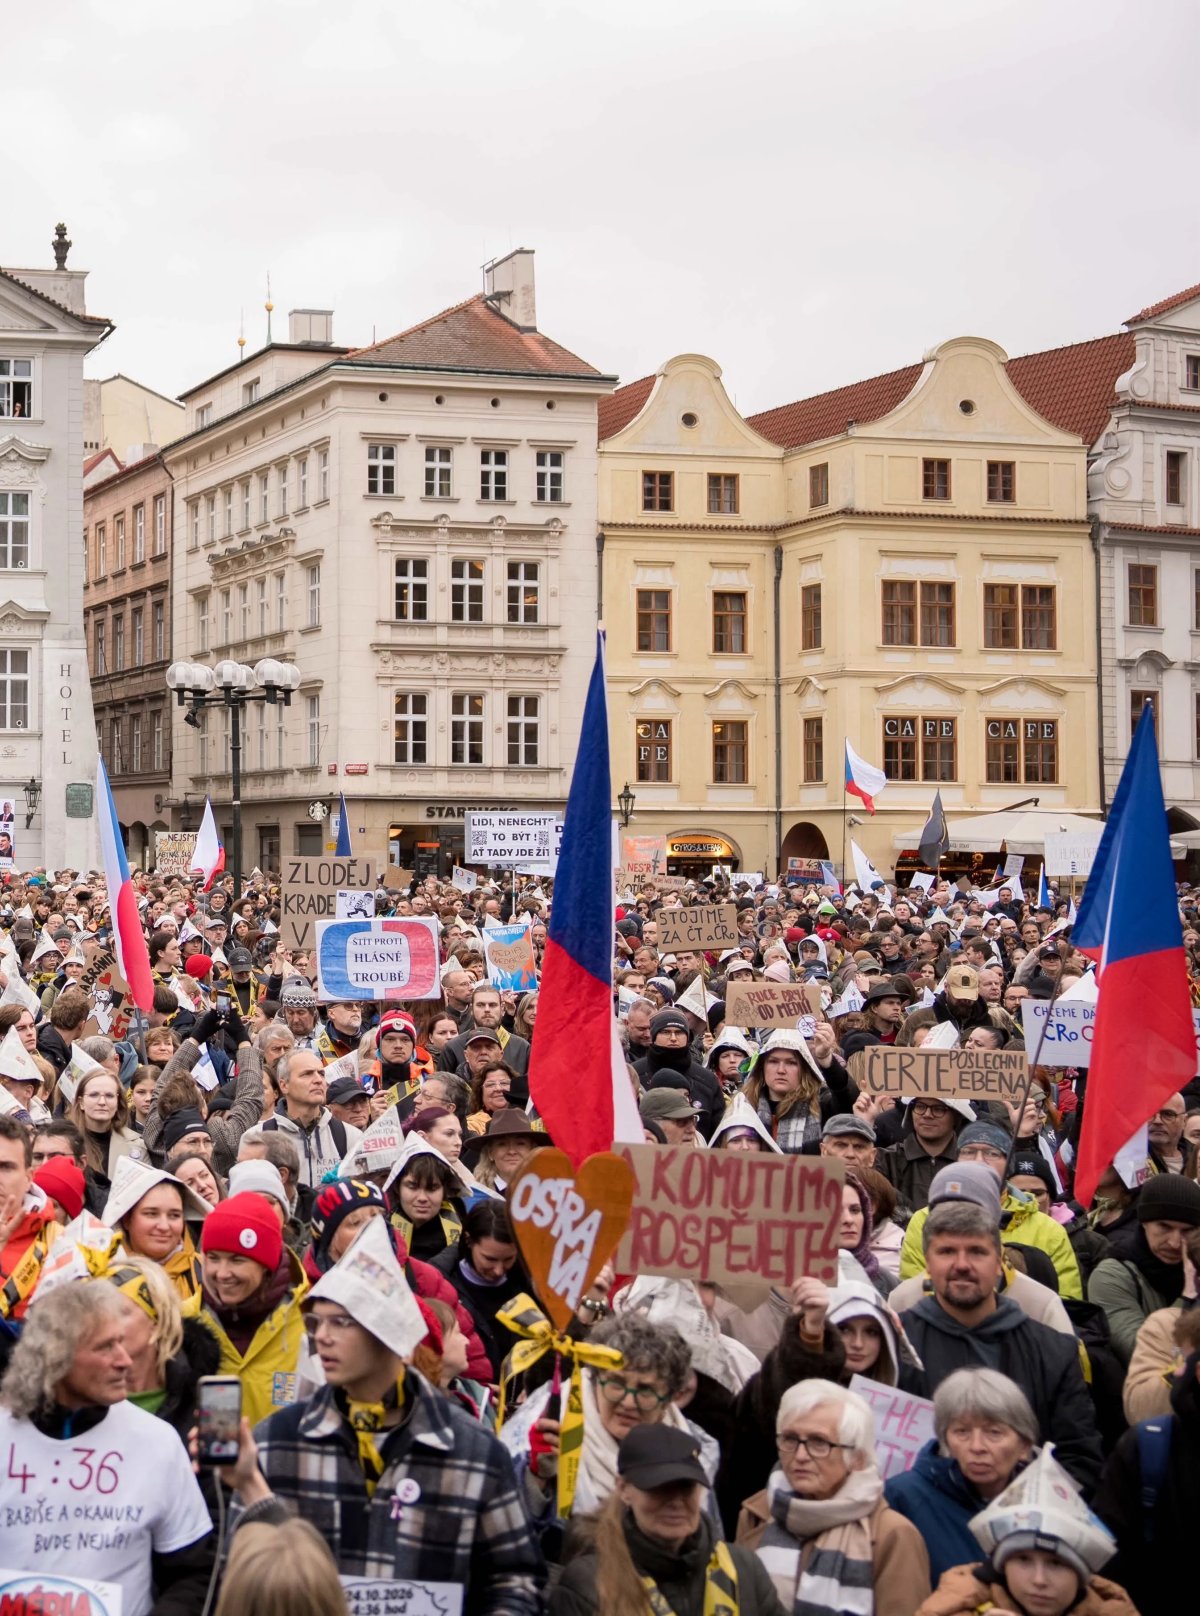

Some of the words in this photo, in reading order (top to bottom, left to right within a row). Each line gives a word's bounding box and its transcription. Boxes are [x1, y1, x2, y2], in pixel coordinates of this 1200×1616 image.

[60, 664, 72, 764] HOTEL
[885, 720, 952, 736] CAFE
[988, 722, 1053, 738] CAFE
[472, 818, 495, 827] LIDI,
[492, 833, 506, 841] TO
[512, 831, 531, 841] BÝT
[472, 847, 484, 857] AŤ
[488, 848, 513, 857] TADY
[515, 848, 534, 857] JDE
[288, 859, 370, 886] ZLODĚJ
[284, 894, 336, 915] KRADE
[659, 908, 726, 926] STOJÍME
[292, 922, 309, 947] V
[352, 937, 373, 945] ŠTÍT
[374, 937, 402, 945] PROTI
[662, 931, 682, 945] ZA
[688, 924, 703, 942] ČT
[714, 923, 735, 940] ČRo
[354, 952, 402, 963] HLÁSNÉ
[745, 989, 778, 1005] RUCE
[758, 1004, 774, 1021] OD
[1033, 1006, 1077, 1017] CHCEME
[950, 1050, 1024, 1070] POSLECHNI
[959, 1070, 1029, 1092] EBENA
[615, 1178, 843, 1287] ROSPĚJETE?
[8, 1442, 124, 1494] 4:36
[6, 1498, 54, 1527] BABIŠE
[58, 1505, 69, 1521] A
[74, 1504, 144, 1522] OKAMURY
[34, 1533, 72, 1554] BUDE
[385, 1601, 407, 1615] hod
